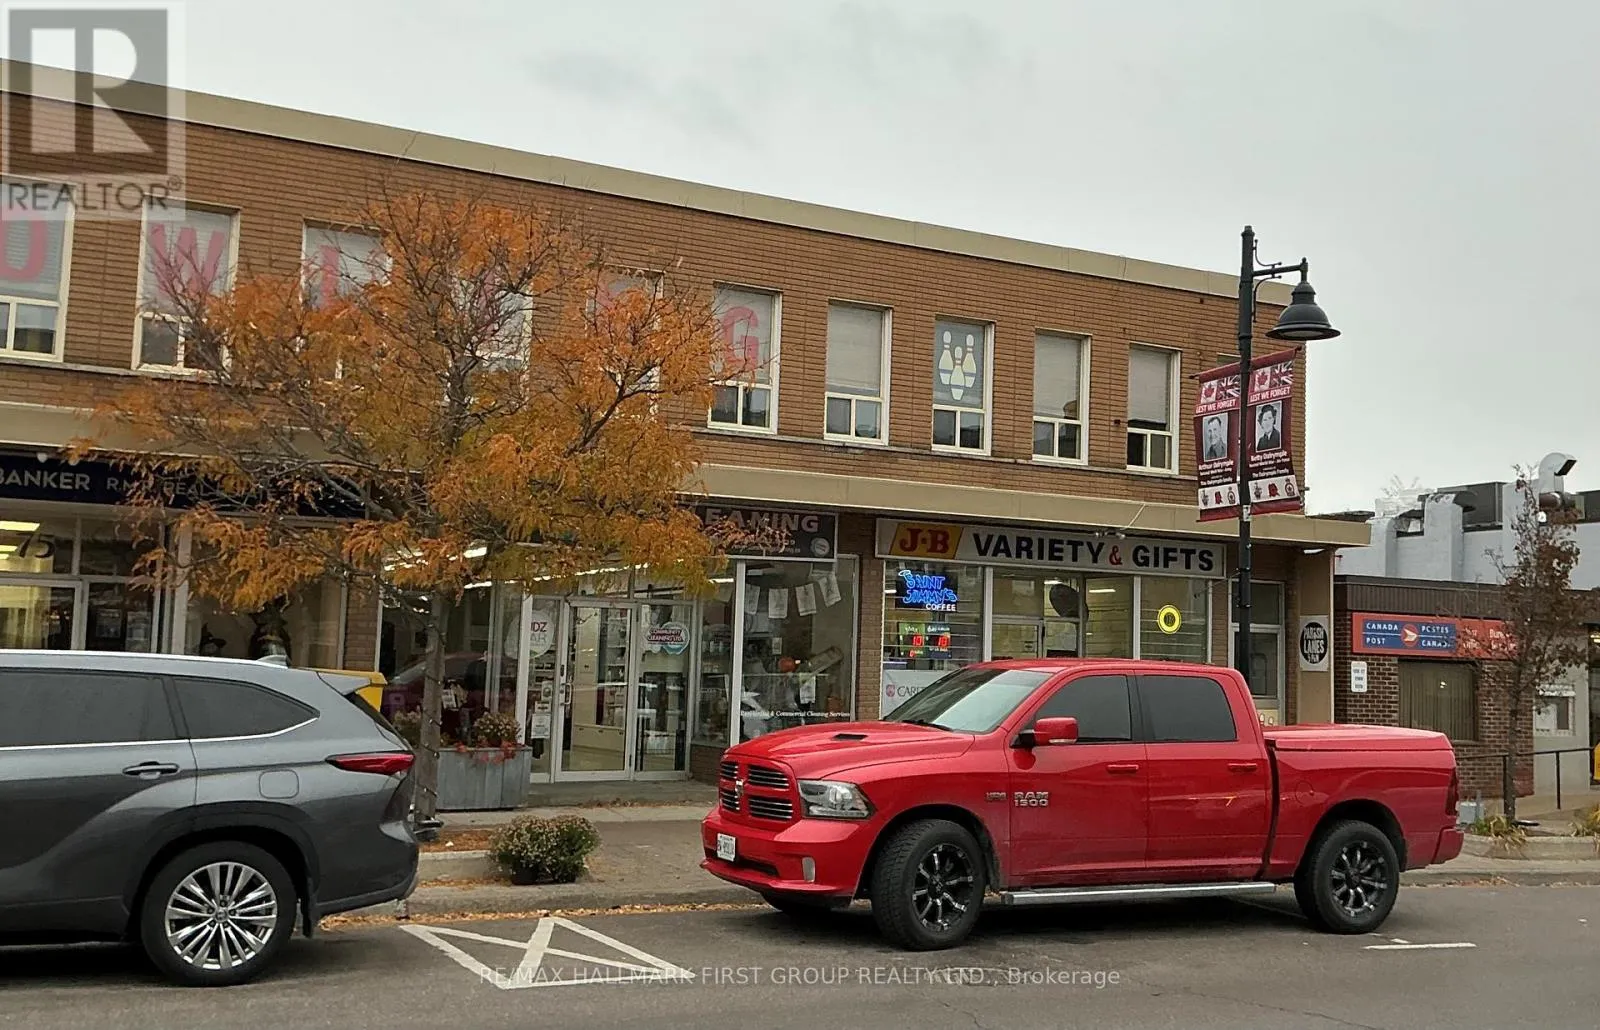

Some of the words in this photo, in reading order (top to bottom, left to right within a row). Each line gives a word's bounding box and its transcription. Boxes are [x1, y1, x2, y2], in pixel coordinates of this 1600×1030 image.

[1270, 386, 1291, 398] FORGET
[1207, 403, 1216, 411] WE
[1217, 399, 1236, 409] FORGET
[973, 533, 1105, 564] VARIETY
[1108, 545, 1123, 566] &
[1132, 545, 1214, 572] GIFTS
[926, 603, 956, 612] COFFEE
[1366, 622, 1398, 631] CANADA
[1303, 639, 1325, 654] LANES
[1366, 637, 1385, 645] POST
